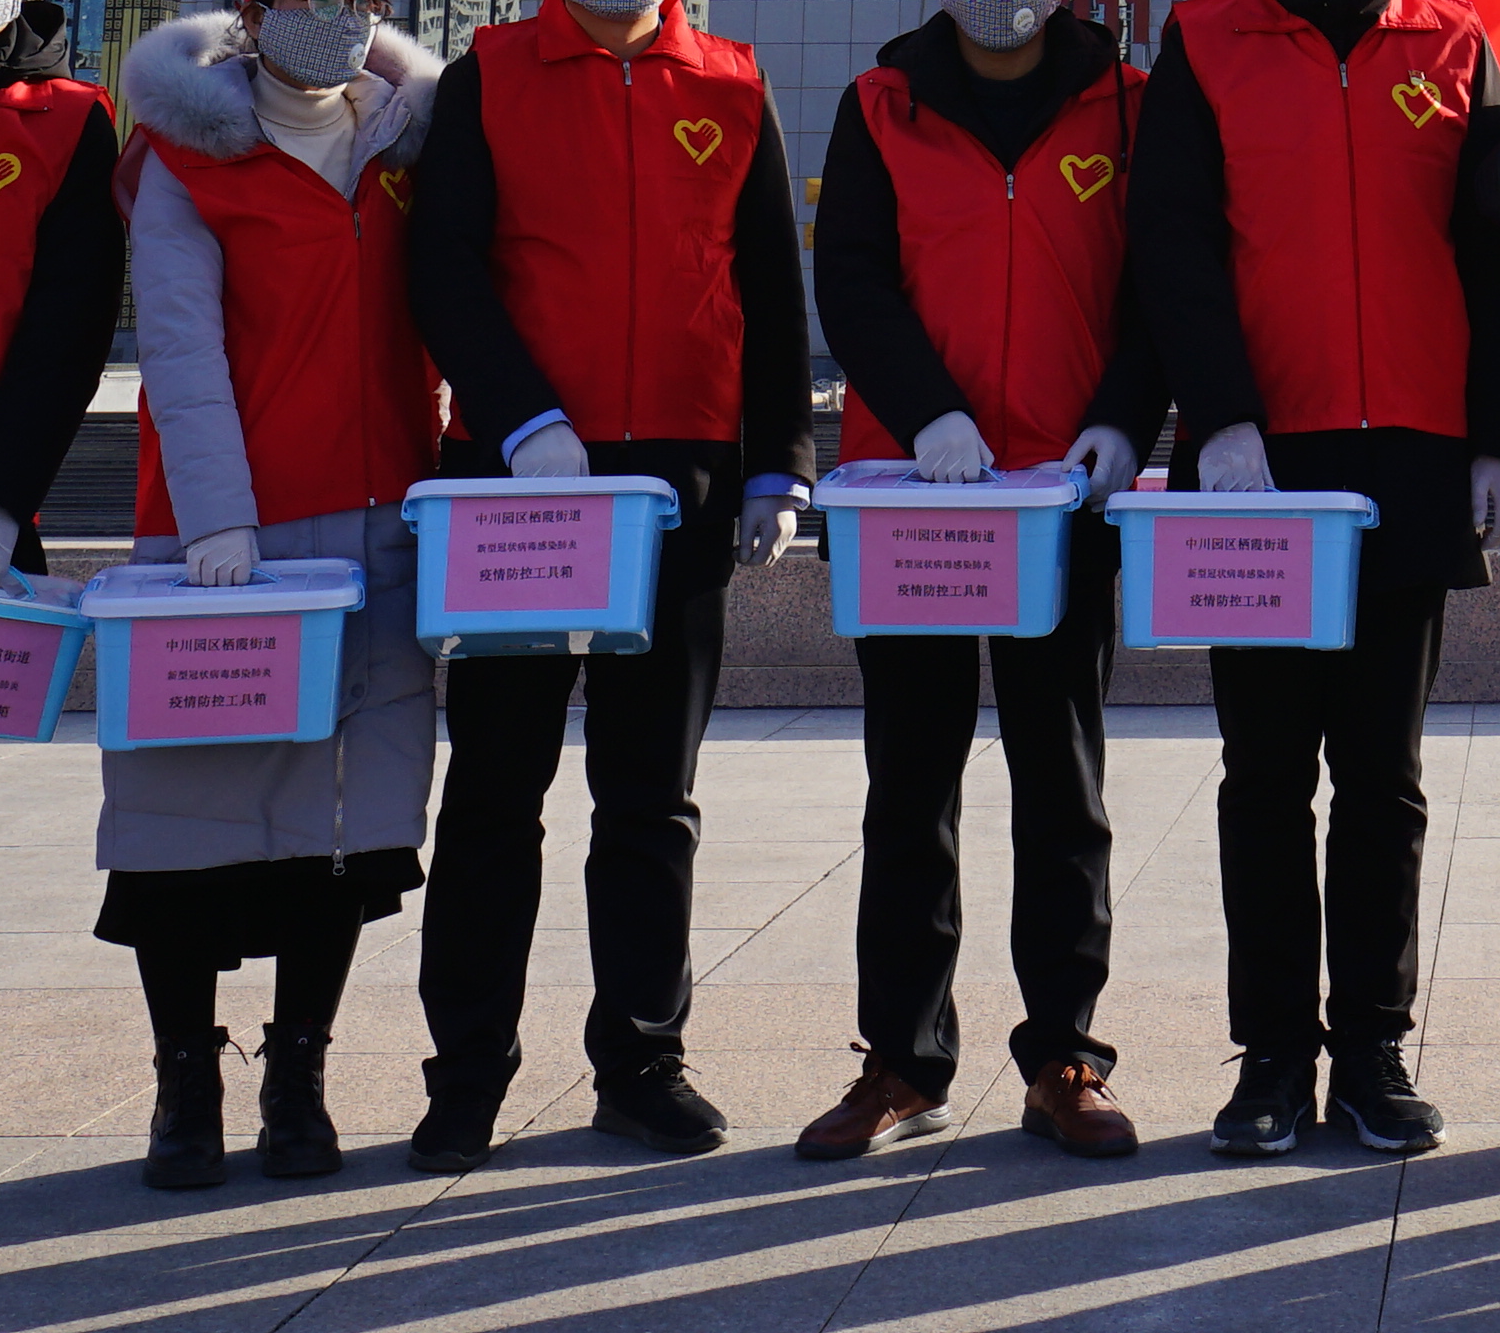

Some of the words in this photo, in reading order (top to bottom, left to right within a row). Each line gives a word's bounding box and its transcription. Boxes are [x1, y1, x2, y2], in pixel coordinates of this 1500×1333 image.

[475, 508, 582, 526] 中川园区栖霞街道
[891, 528, 996, 544] 中川园区栖霞街道
[476, 539, 577, 554] 新型冠状病毒感染肺炎
[1185, 537, 1289, 552] 中川园区栖霞街道
[894, 559, 992, 571] 新型冠状病毒感染肺炎
[479, 565, 573, 582] 疫情防控工具箱
[1187, 568, 1285, 580] 新型冠状病毒感染肺炎
[897, 583, 988, 598] 疫情防控工具箱
[1189, 593, 1282, 608] 疫情防控工具箱
[166, 636, 277, 653] 中川园区栖霞街道
[167, 667, 272, 681] 新型冠状病毒感染肺炎
[168, 692, 267, 709] 疫情防控工具箱
